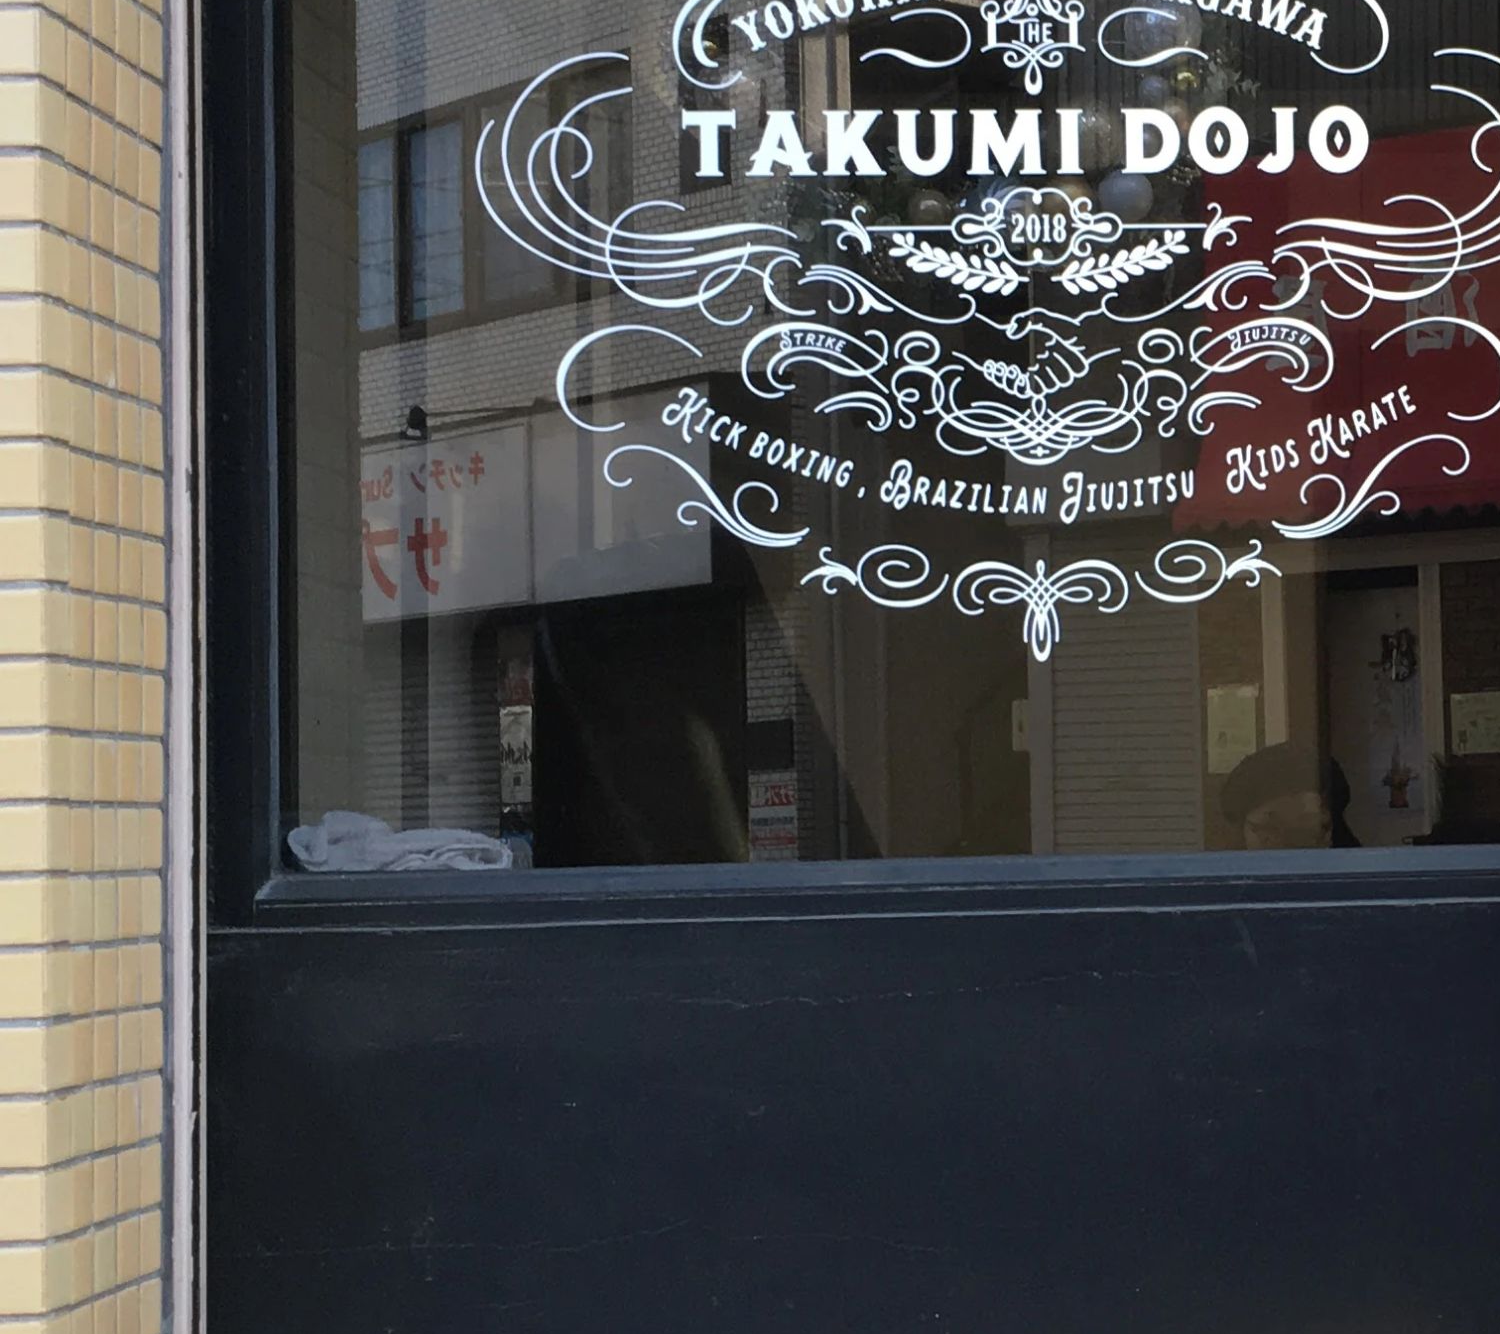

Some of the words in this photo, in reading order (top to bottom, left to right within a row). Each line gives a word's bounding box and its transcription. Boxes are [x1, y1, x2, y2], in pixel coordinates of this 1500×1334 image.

[1008, 17, 1055, 45] THE
[681, 108, 1084, 177] TAKUMI
[1120, 104, 1369, 175] DOJO
[1010, 213, 1067, 244] 2018
